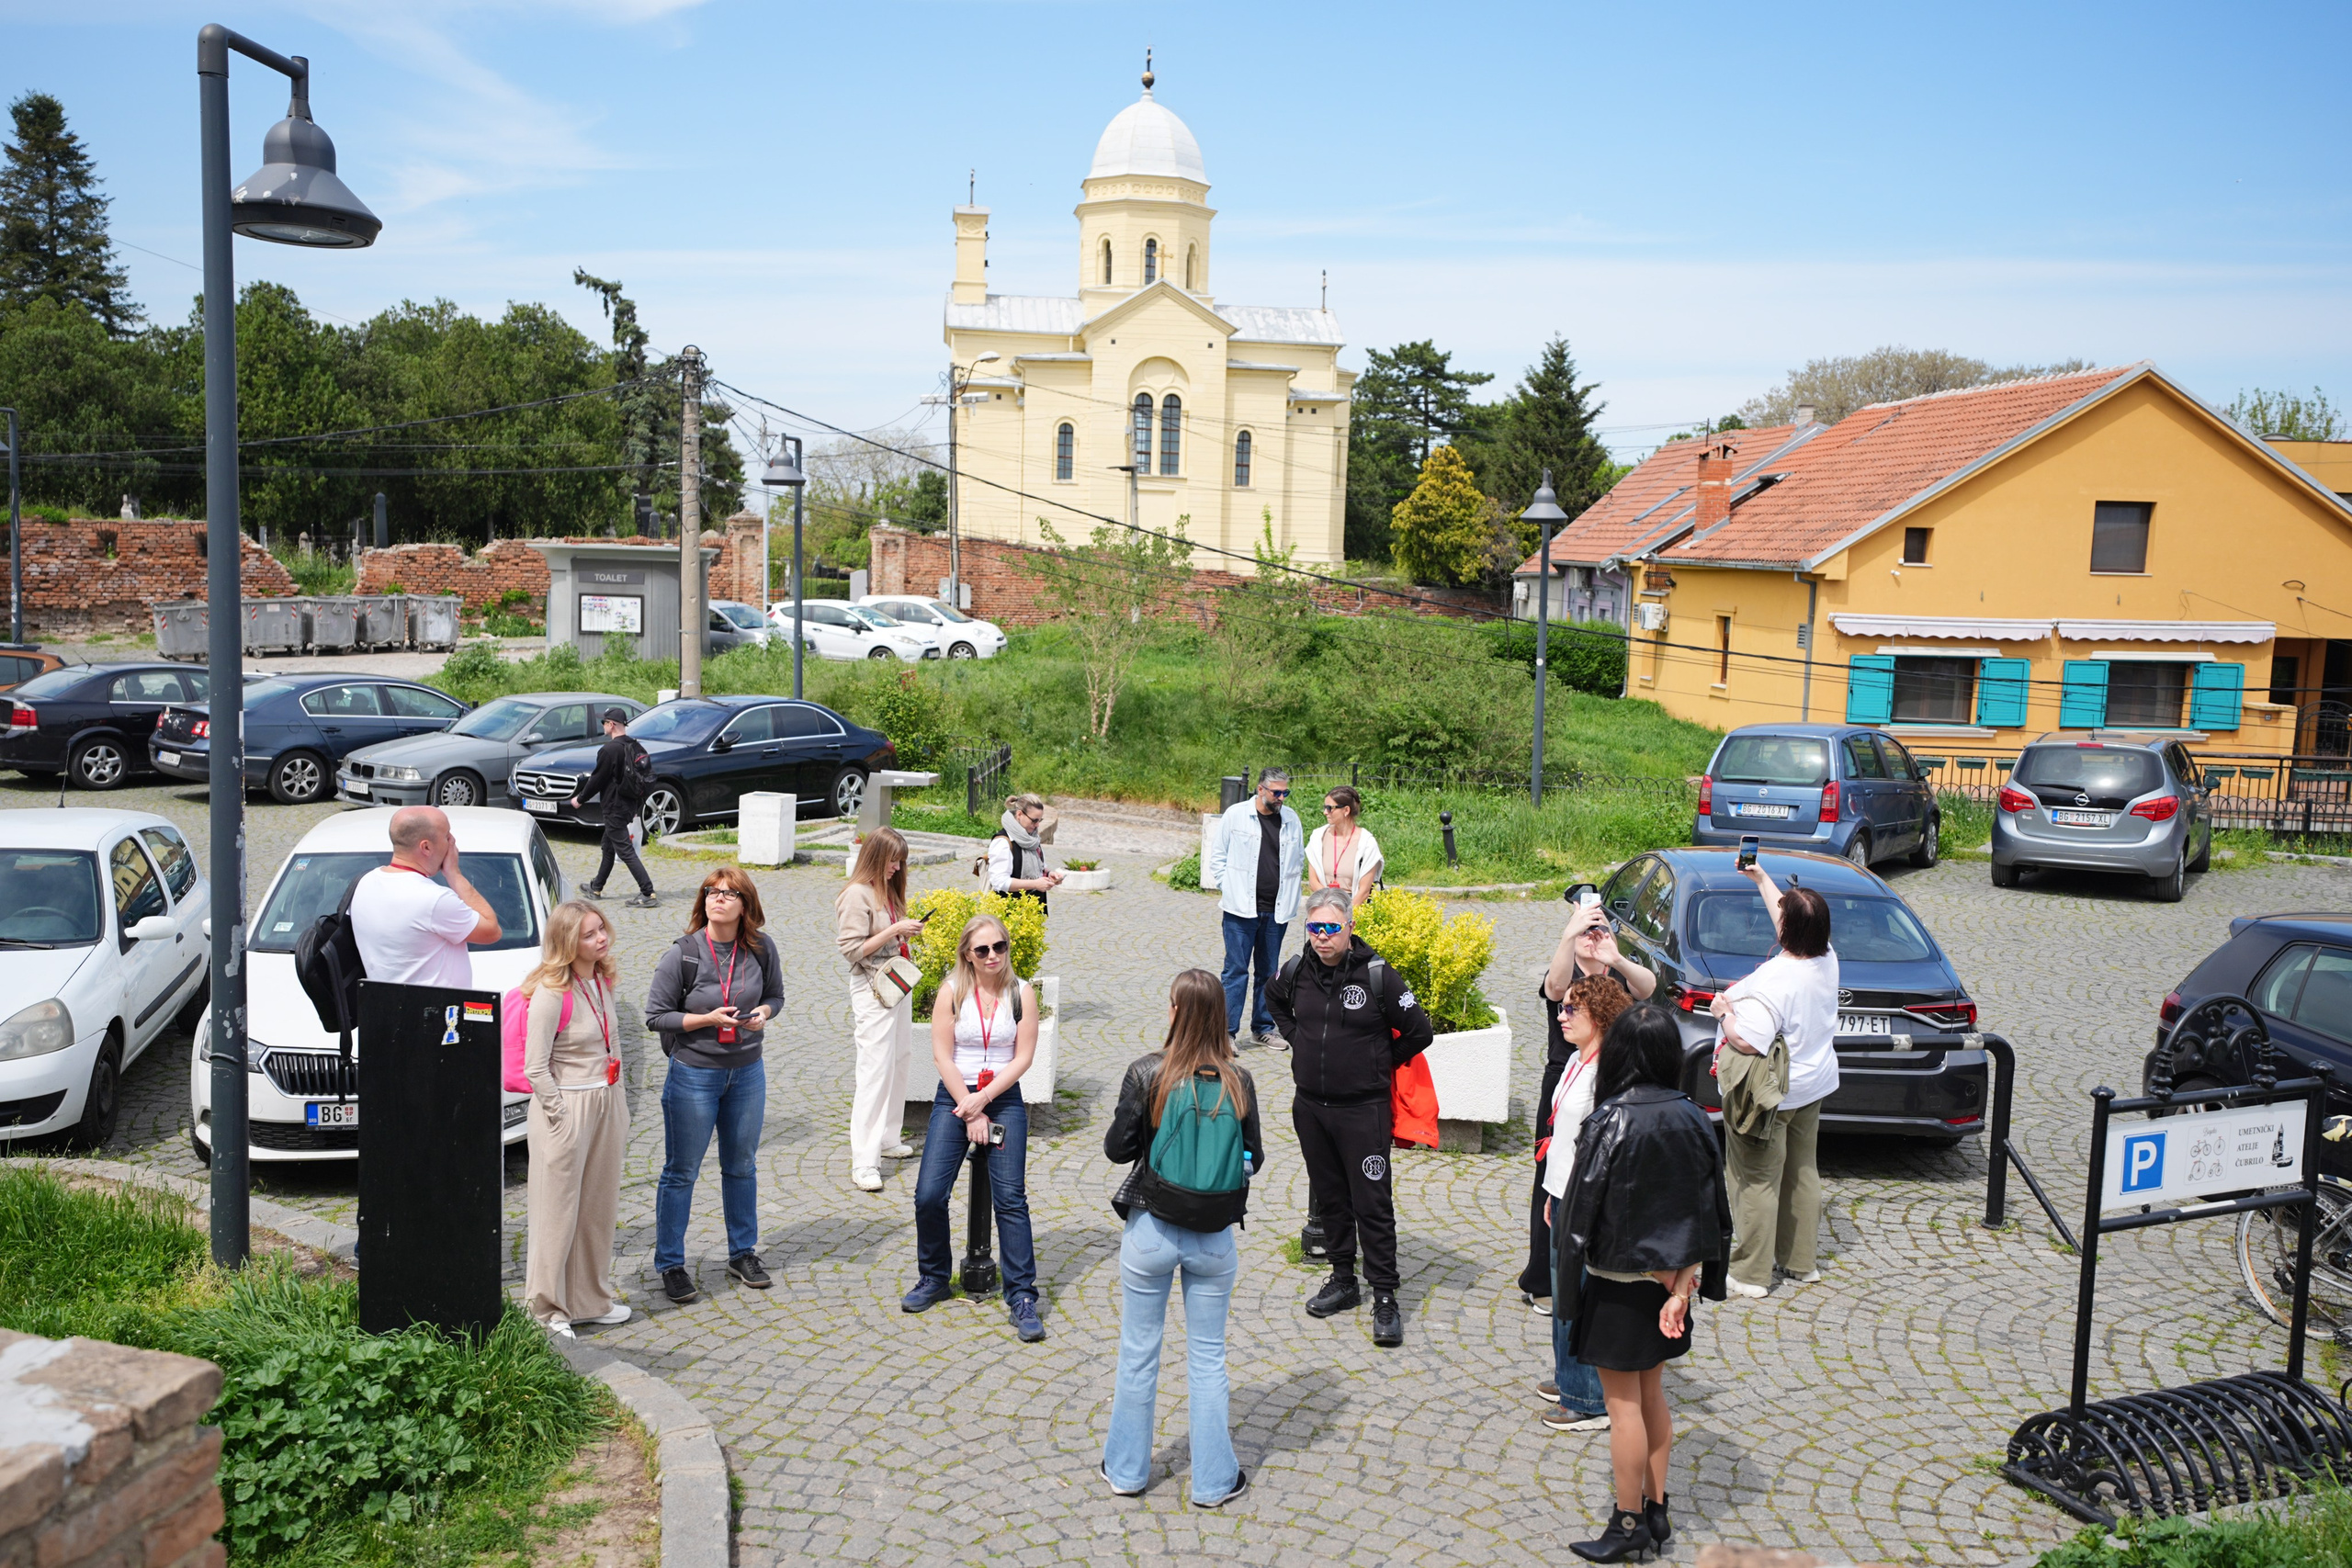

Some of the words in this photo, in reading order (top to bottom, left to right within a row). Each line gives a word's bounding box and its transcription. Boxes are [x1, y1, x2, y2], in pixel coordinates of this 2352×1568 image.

[594, 573, 628, 582] TOALET
[1742, 805, 1752, 813] BG
[2059, 812, 2069, 821] BG
[322, 1106, 342, 1122] BG
[2238, 1124, 2275, 1136] UMETNIČKI
[2236, 1142, 2259, 1152] ATELJE
[2130, 1140, 2157, 1187] P
[2234, 1156, 2264, 1168] ČUBRILO
